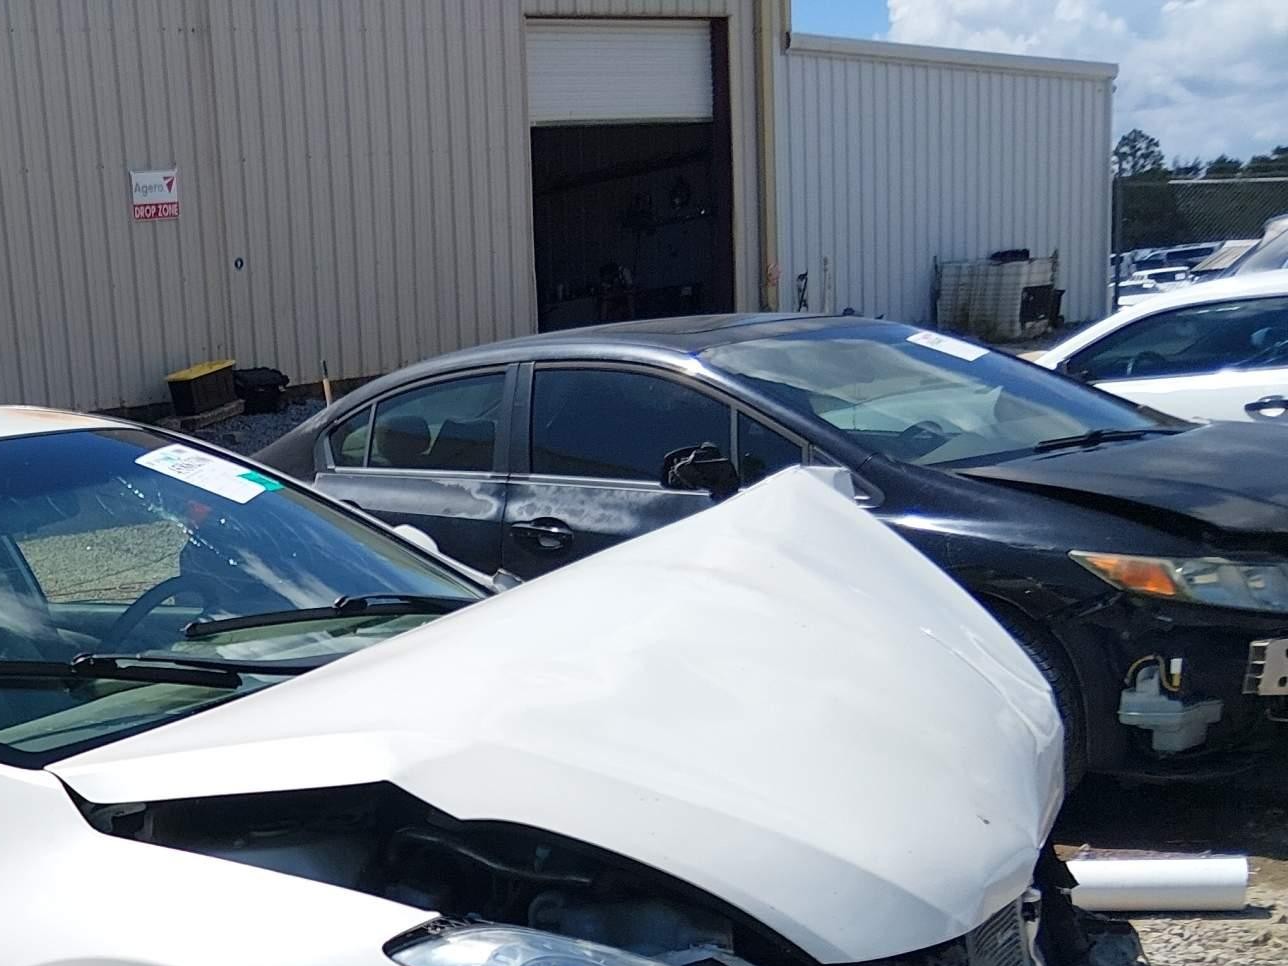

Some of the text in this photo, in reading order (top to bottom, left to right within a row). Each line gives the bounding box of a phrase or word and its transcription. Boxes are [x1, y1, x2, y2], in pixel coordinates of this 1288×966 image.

[134, 182, 164, 197] Agero
[134, 203, 178, 218] DROP ZONE
